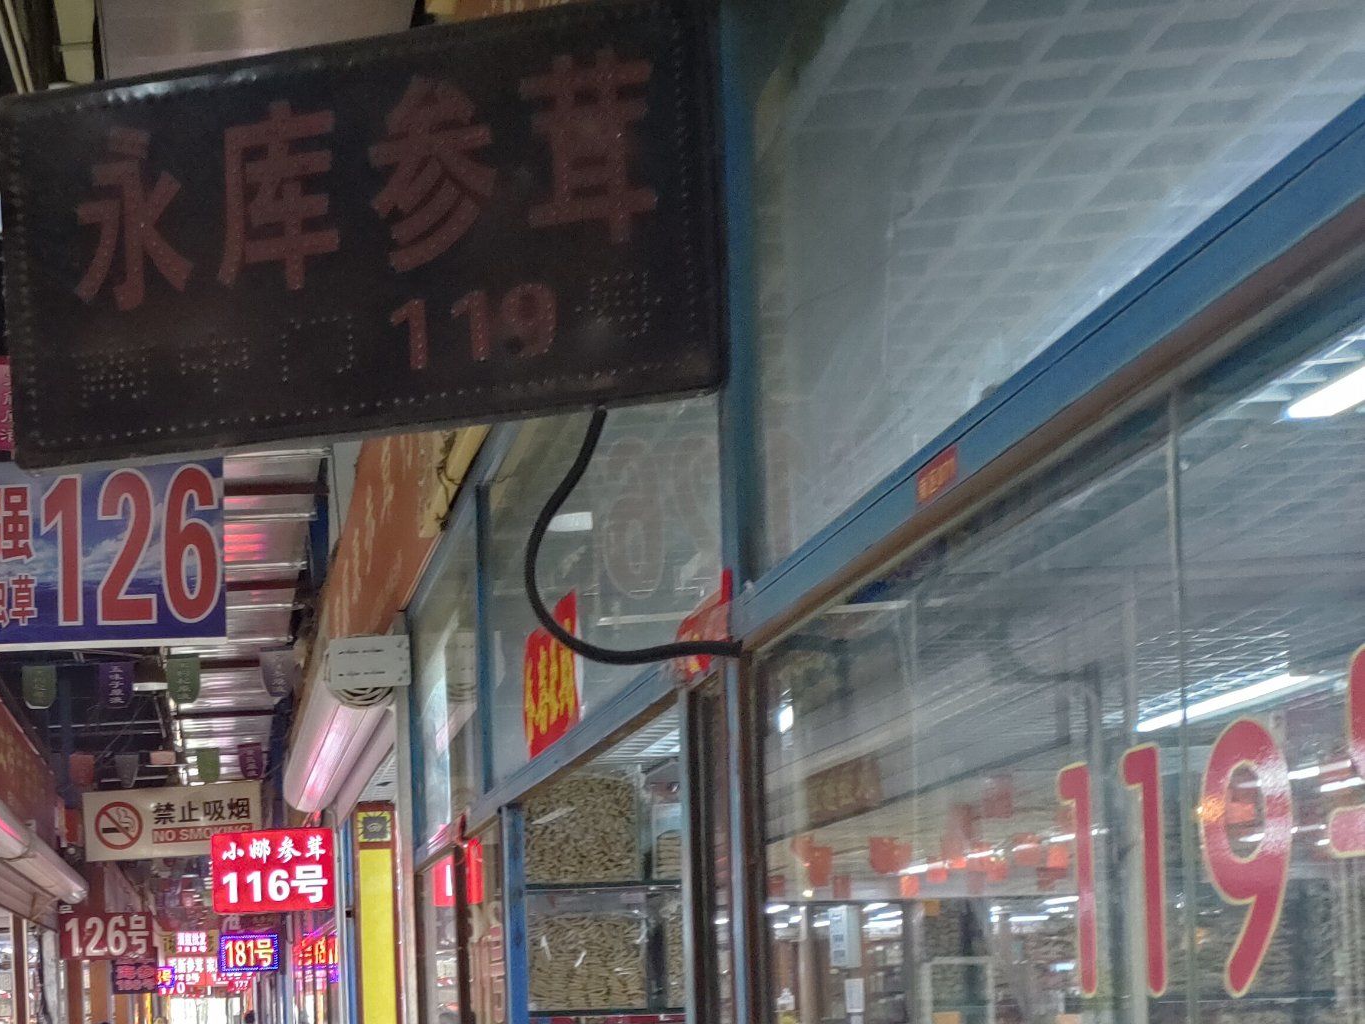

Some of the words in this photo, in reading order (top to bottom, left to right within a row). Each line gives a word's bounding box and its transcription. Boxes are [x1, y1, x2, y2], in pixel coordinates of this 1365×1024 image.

[75, 46, 658, 311] 永库参茸
[40, 463, 222, 627] 126
[153, 797, 250, 825] 禁止吸烟
[1057, 643, 1365, 998] 119
[155, 830, 177, 842] NO
[223, 864, 328, 904] 116号
[64, 914, 150, 957] 126号
[225, 938, 273, 968] 181号
